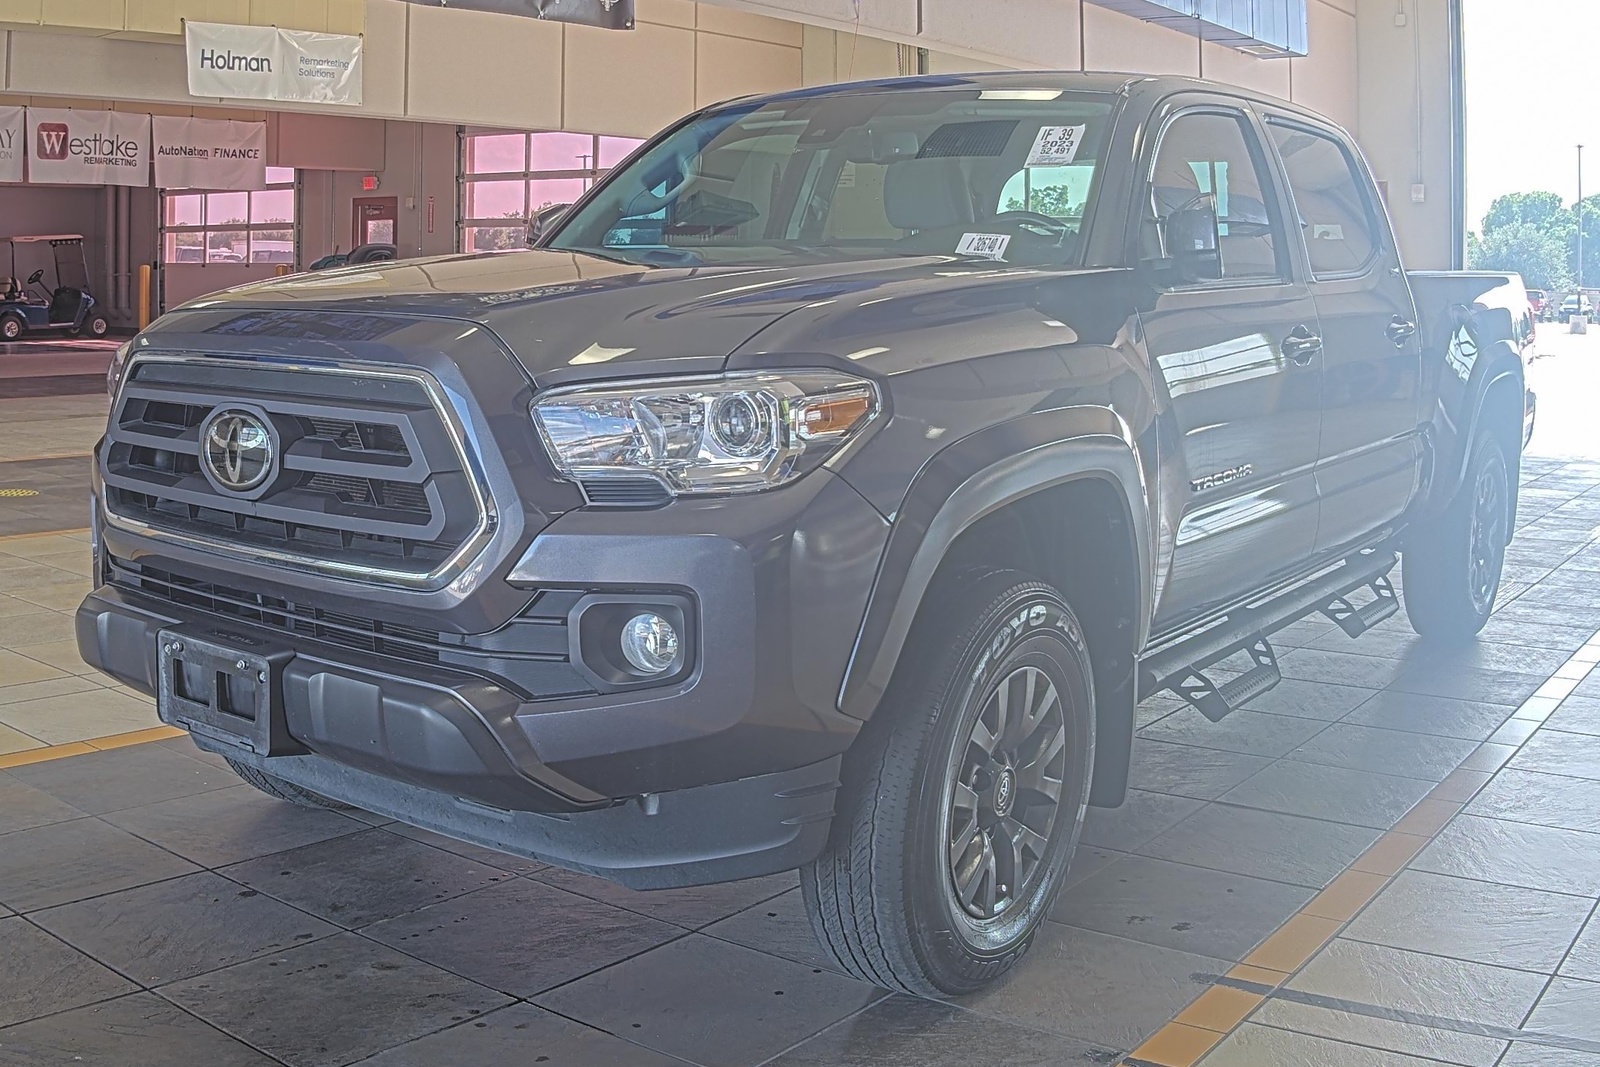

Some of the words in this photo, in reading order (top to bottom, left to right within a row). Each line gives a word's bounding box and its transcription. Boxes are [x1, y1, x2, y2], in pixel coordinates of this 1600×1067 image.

[200, 48, 272, 73] Holman
[299, 56, 350, 70] Remarketing
[298, 68, 336, 79] Solutions
[1040, 128, 1055, 141] IF
[1058, 128, 1074, 141] 39
[38, 126, 139, 159] Westlake
[1041, 140, 1075, 148] 2023
[158, 145, 209, 158] AutoNation
[213, 147, 260, 160] FINANCE
[1040, 147, 1071, 155] 52,491
[83, 156, 138, 168] REMARKETING
[1190, 463, 1253, 492] TACOMA
[972, 604, 1047, 685] TOYO
